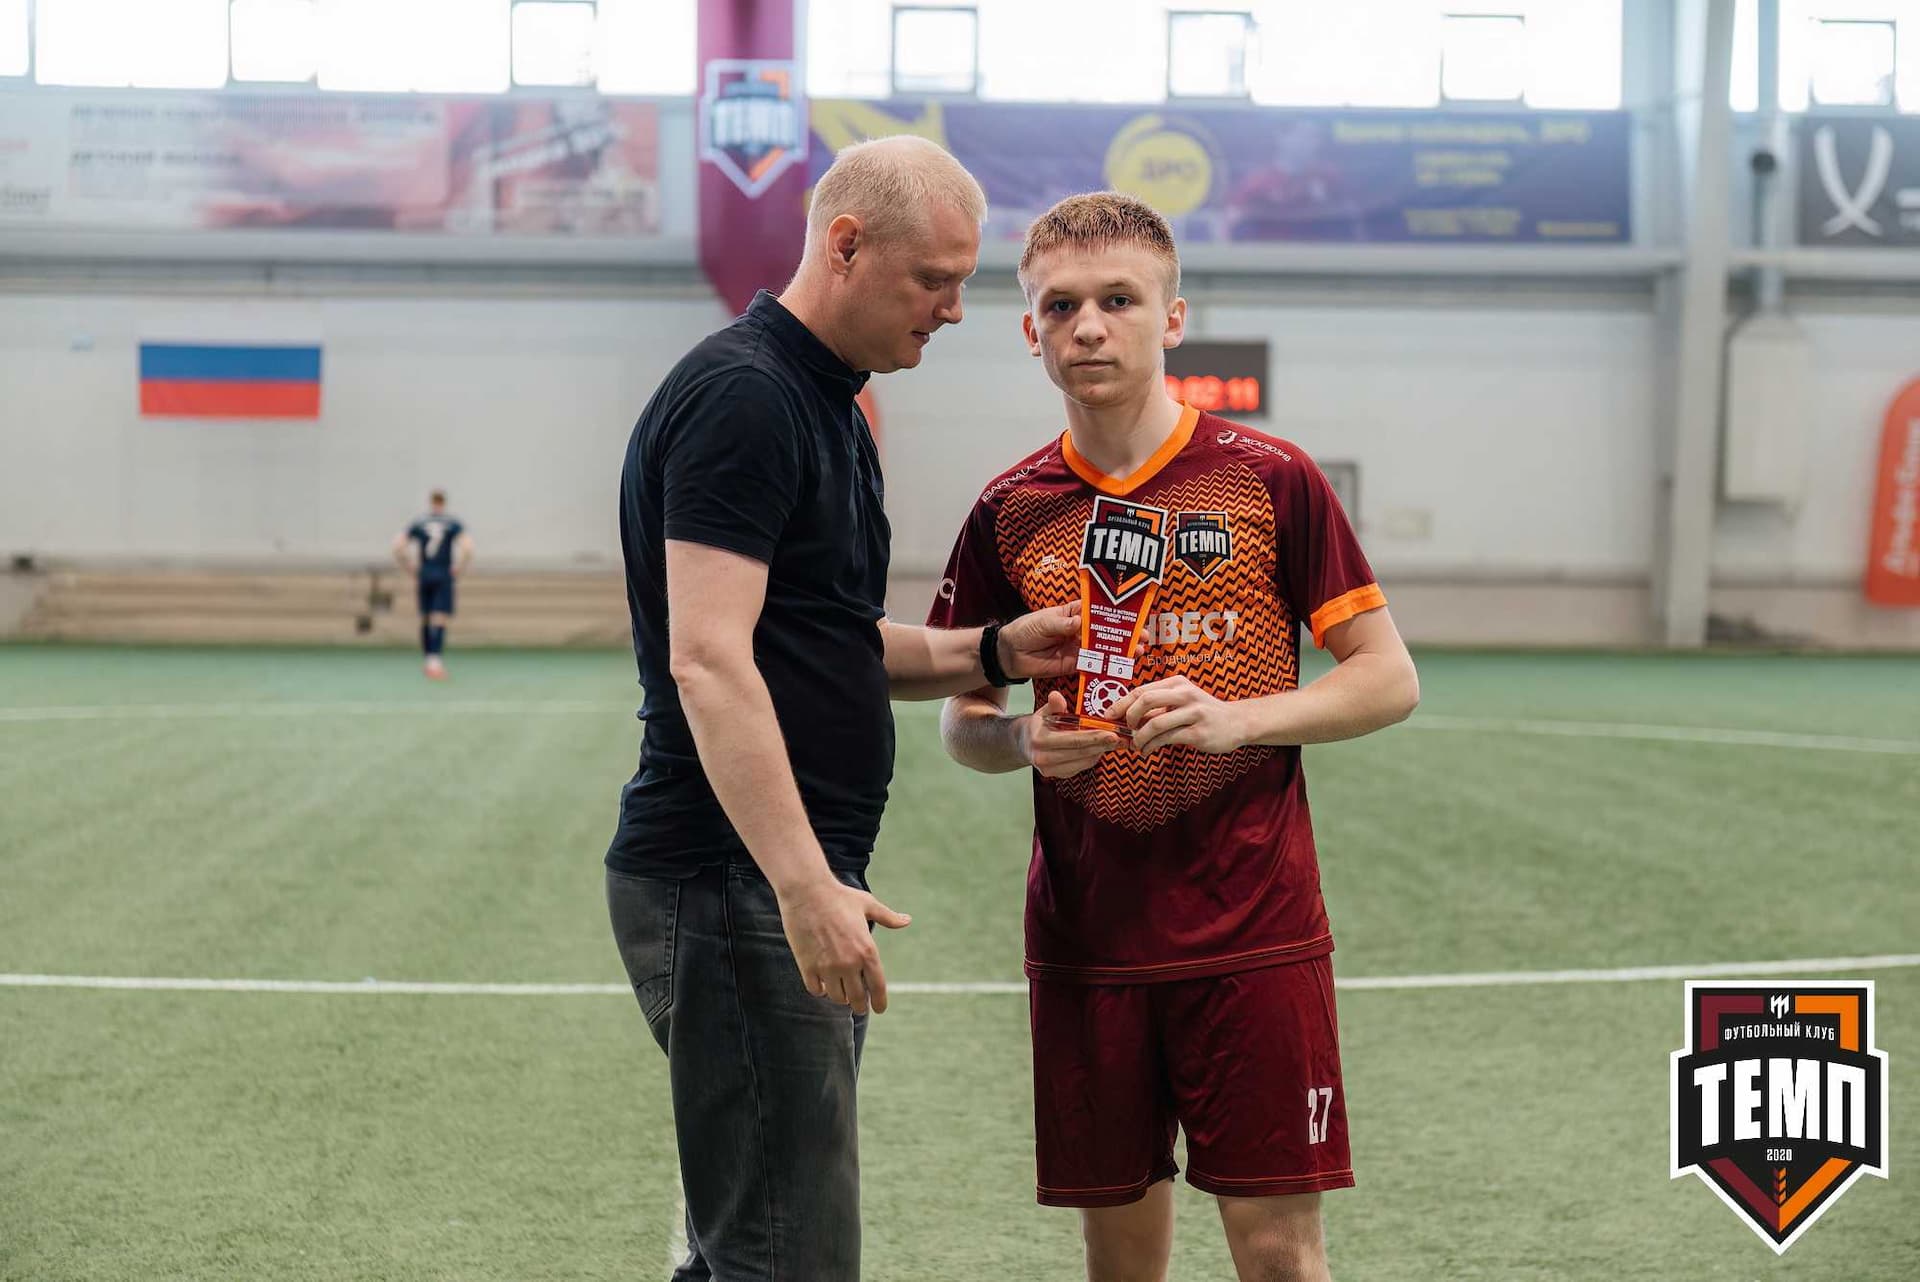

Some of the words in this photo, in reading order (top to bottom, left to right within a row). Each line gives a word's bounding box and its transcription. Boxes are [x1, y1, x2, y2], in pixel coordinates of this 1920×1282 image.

[425, 521, 445, 559] 7
[1092, 528, 1160, 572] ТЕМП
[1179, 530, 1227, 555] ТЕМП
[1090, 623, 1132, 637] КОНСТАНТИН
[1307, 1087, 1333, 1145] 27
